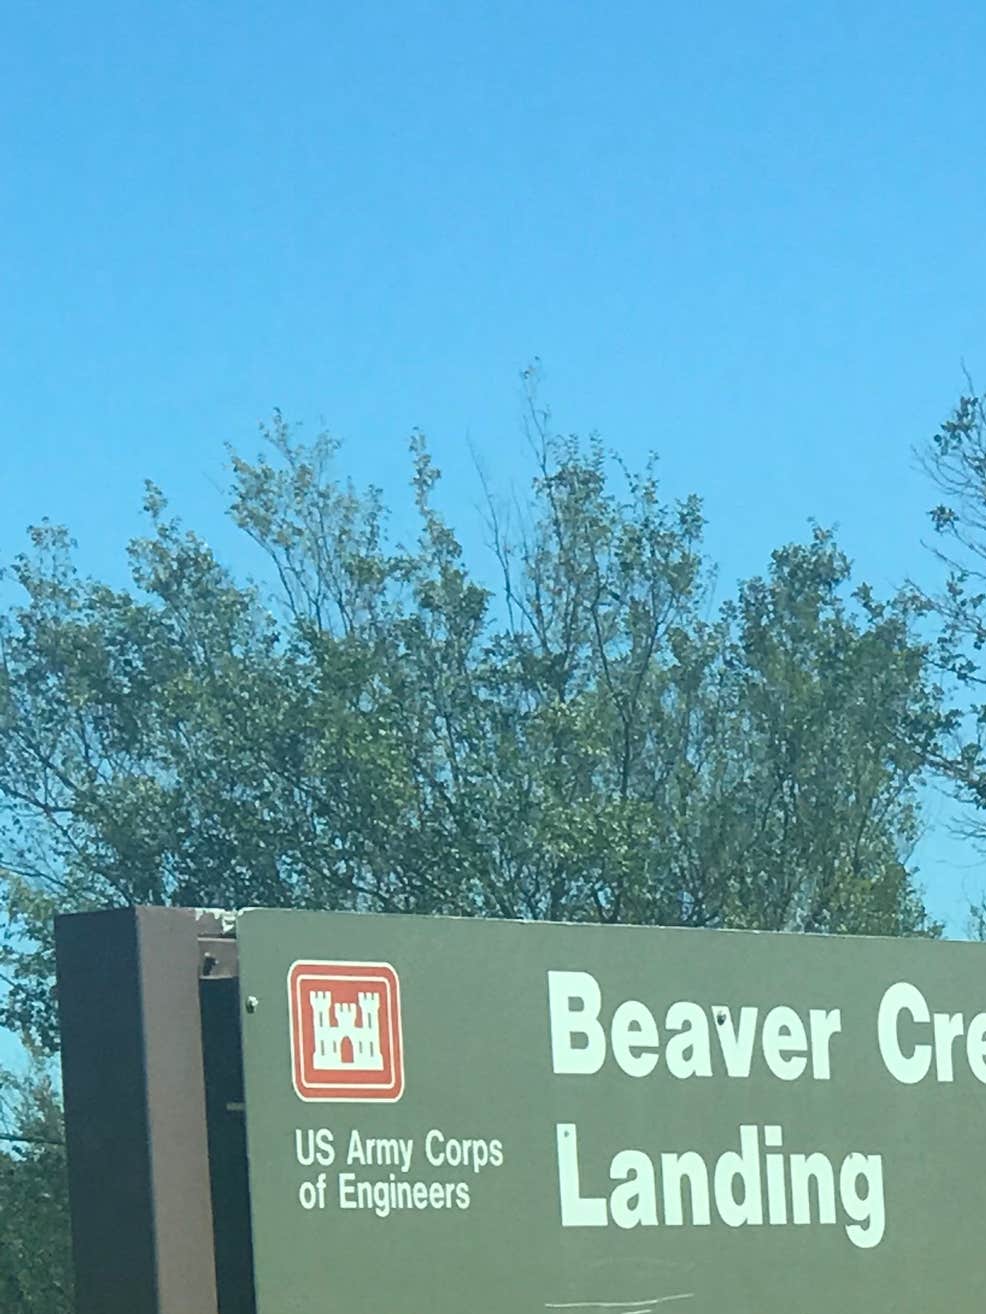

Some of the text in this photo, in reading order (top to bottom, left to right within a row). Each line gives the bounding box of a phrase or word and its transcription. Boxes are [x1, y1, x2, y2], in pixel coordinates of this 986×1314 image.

[547, 970, 842, 1081] Beaver
[295, 1128, 504, 1174] US Army Corps
[556, 1123, 886, 1249] Landing
[299, 1172, 471, 1218] of Engineers
